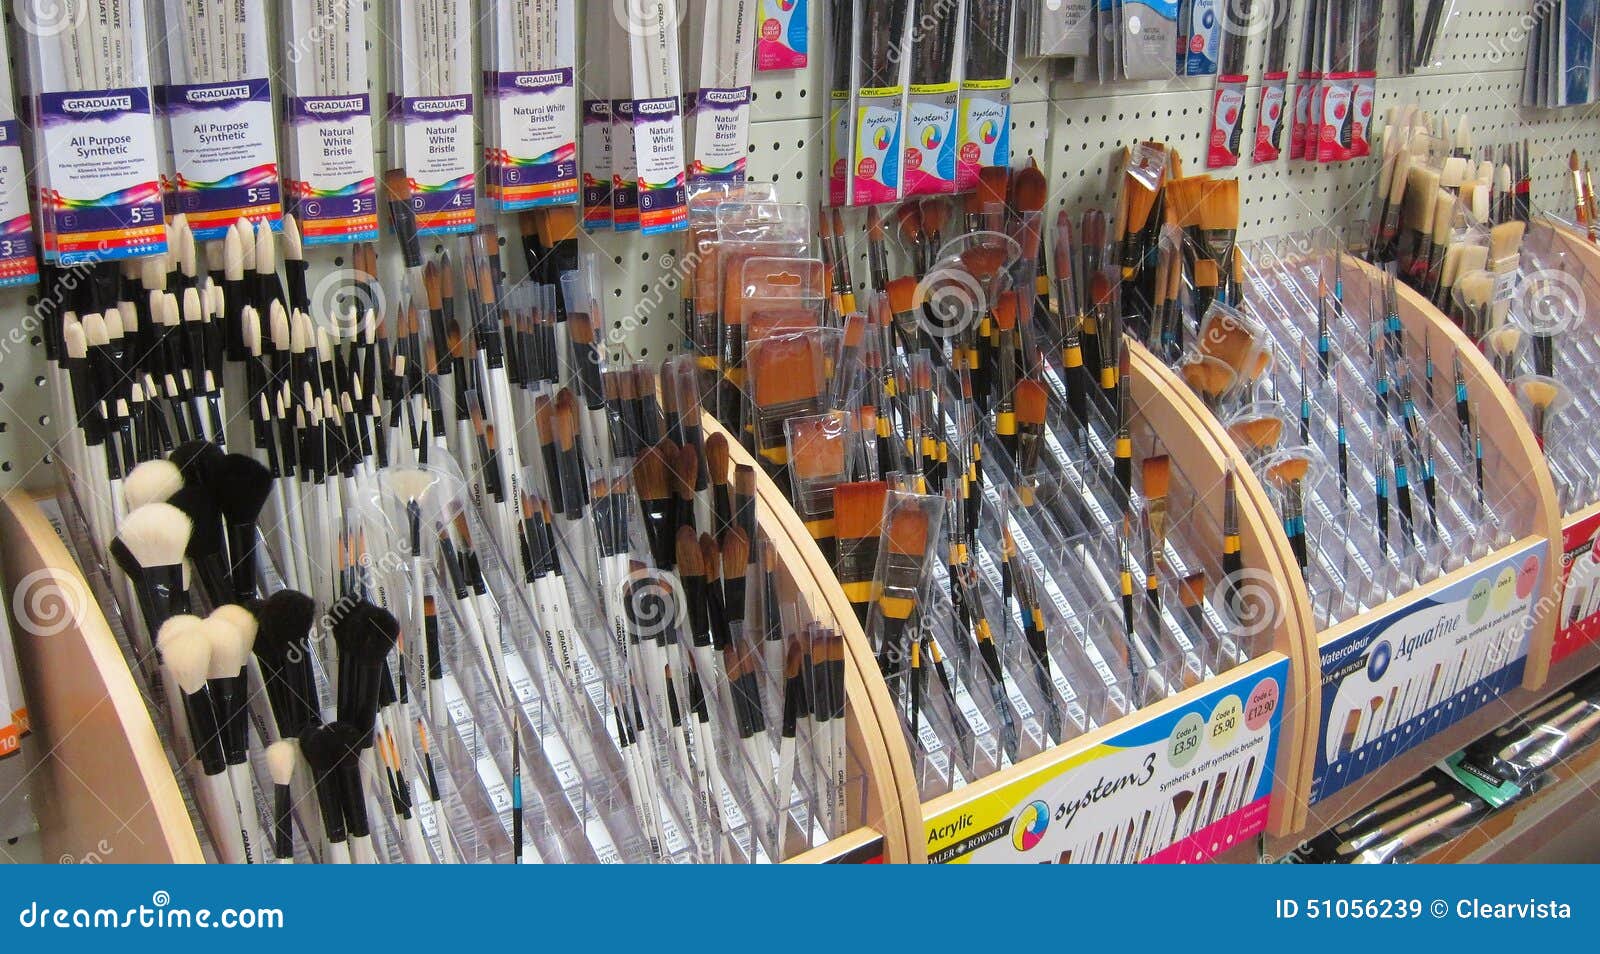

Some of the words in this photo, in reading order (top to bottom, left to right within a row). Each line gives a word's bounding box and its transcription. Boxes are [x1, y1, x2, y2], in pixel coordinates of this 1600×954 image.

[519, 73, 562, 85] GRADUATE
[191, 87, 248, 100] GRADUATE
[68, 97, 129, 110] GRADUATE
[309, 100, 362, 110] GRADUATE
[417, 100, 464, 110] GRADUATE
[513, 105, 545, 116] Natural
[547, 103, 566, 113] White
[530, 114, 554, 124] Bristle
[913, 111, 949, 127] system3
[972, 107, 1004, 121] system3
[193, 124, 207, 134] All
[210, 121, 249, 134] Purpose
[320, 127, 354, 137] Natural
[425, 126, 457, 136] Natural
[70, 137, 86, 147] All
[89, 135, 132, 149] Purpose
[199, 131, 246, 145] Synthetic
[323, 138, 352, 147] White
[429, 135, 455, 145] White
[77, 145, 128, 159] Synthetic
[323, 147, 353, 157] Bristle
[429, 145, 456, 154] Bristle
[557, 164, 564, 177] 5
[247, 188, 258, 202] 5
[452, 194, 462, 207] 4
[352, 199, 361, 213] 3
[131, 208, 141, 223] 5
[2, 240, 13, 256] 3
[1393, 613, 1461, 662] Aquafine
[558, 629, 571, 670] GRADUATE
[1321, 635, 1370, 667] Watercolour
[1252, 692, 1267, 704] Code
[1215, 709, 1232, 721] Code
[1248, 700, 1274, 721] £12.90
[1175, 727, 1192, 740] Code
[1212, 716, 1235, 737] £5.90
[1, 735, 17, 750] 10
[1173, 734, 1198, 756] £3.50
[1159, 771, 1190, 793] Synthetic
[1197, 760, 1211, 774] stiff
[1211, 745, 1240, 767] synthetic
[1240, 734, 1265, 753] brushes
[1054, 752, 1157, 829] system3
[927, 814, 973, 845] Acrylic
[968, 825, 1005, 850] ROWNEY
